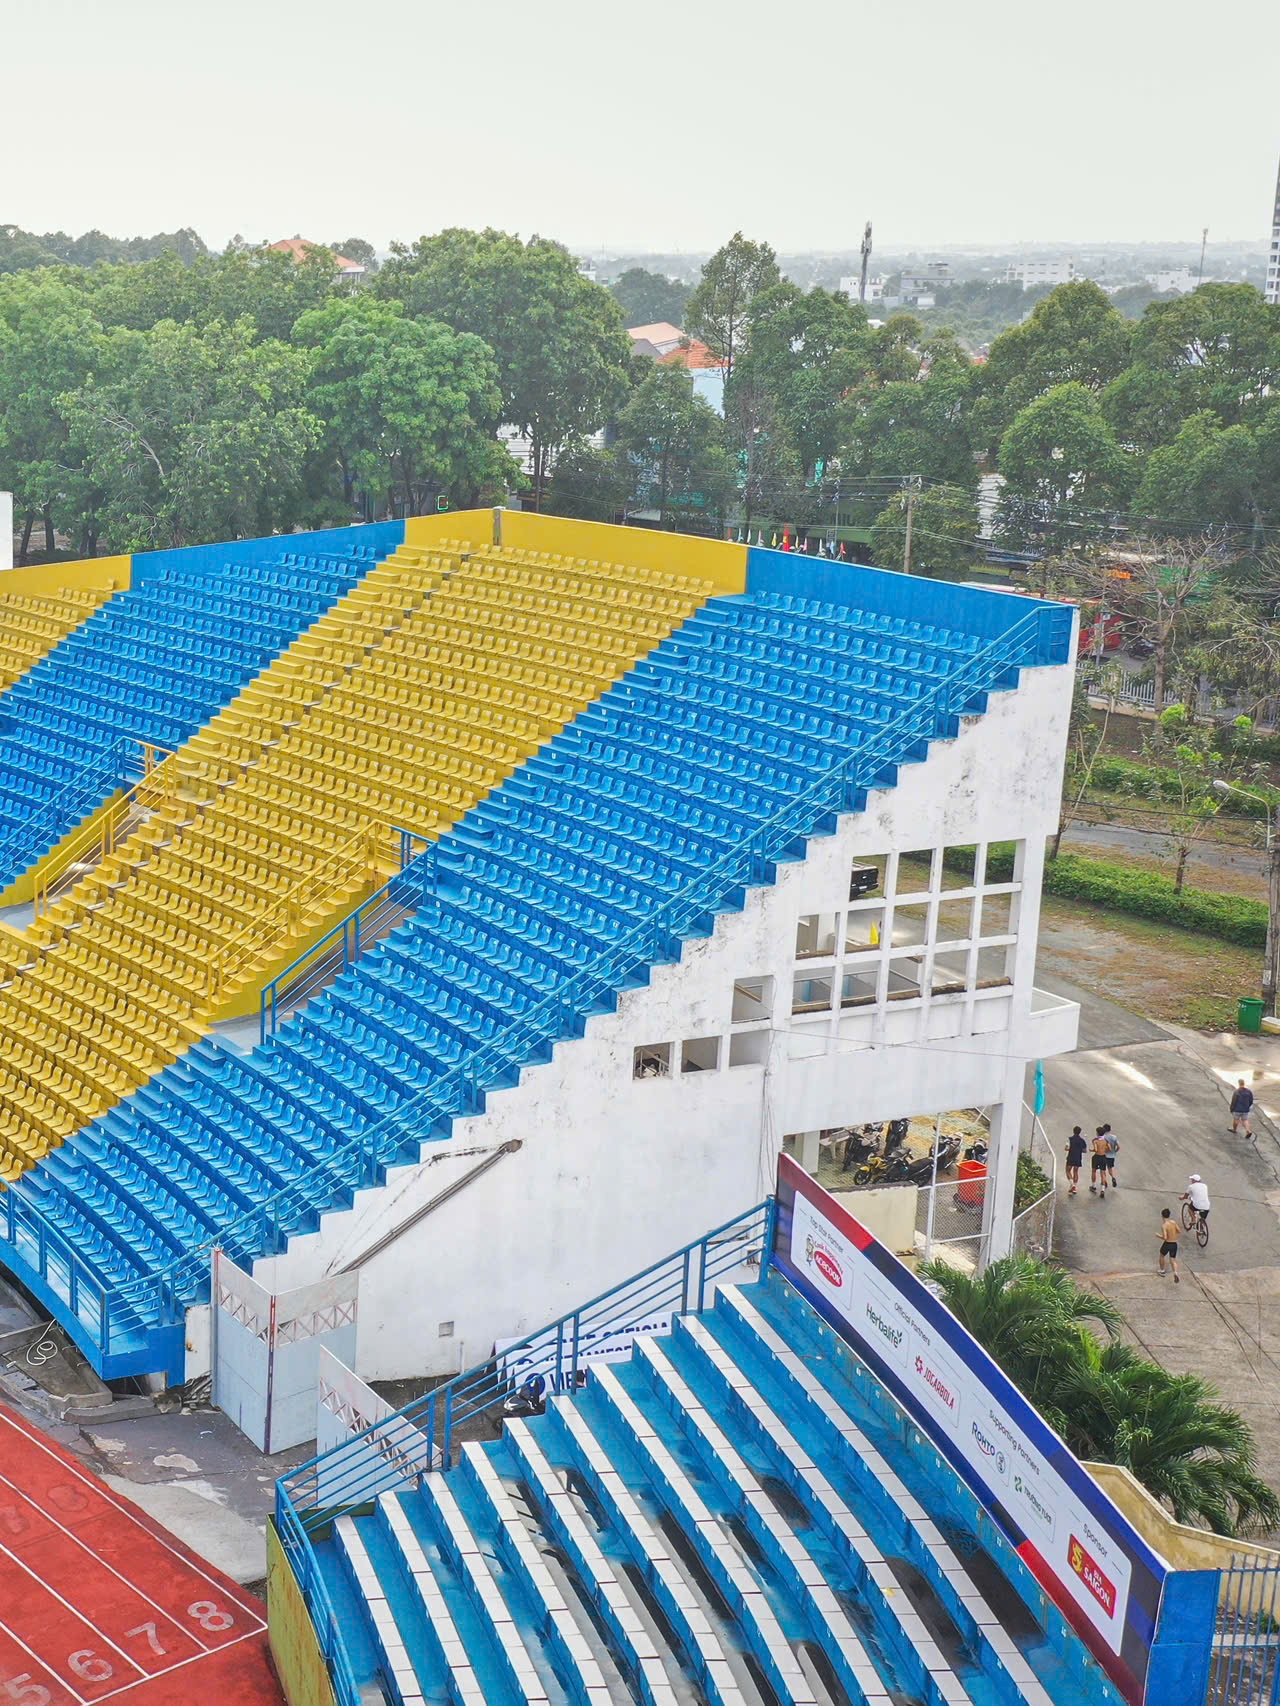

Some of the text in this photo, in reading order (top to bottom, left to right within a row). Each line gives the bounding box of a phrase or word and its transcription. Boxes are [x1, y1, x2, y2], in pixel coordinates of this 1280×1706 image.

[866, 1303, 899, 1348] Herbalife
[894, 1302, 931, 1346] Official Partners
[989, 1409, 1017, 1450] Supporting
[1017, 1443, 1040, 1475] Partners
[1083, 1524, 1108, 1557] Sponsor
[187, 1600, 234, 1631] 8
[124, 1622, 166, 1656] 7
[68, 1649, 113, 1682] 6
[4, 1673, 51, 1706] 5
